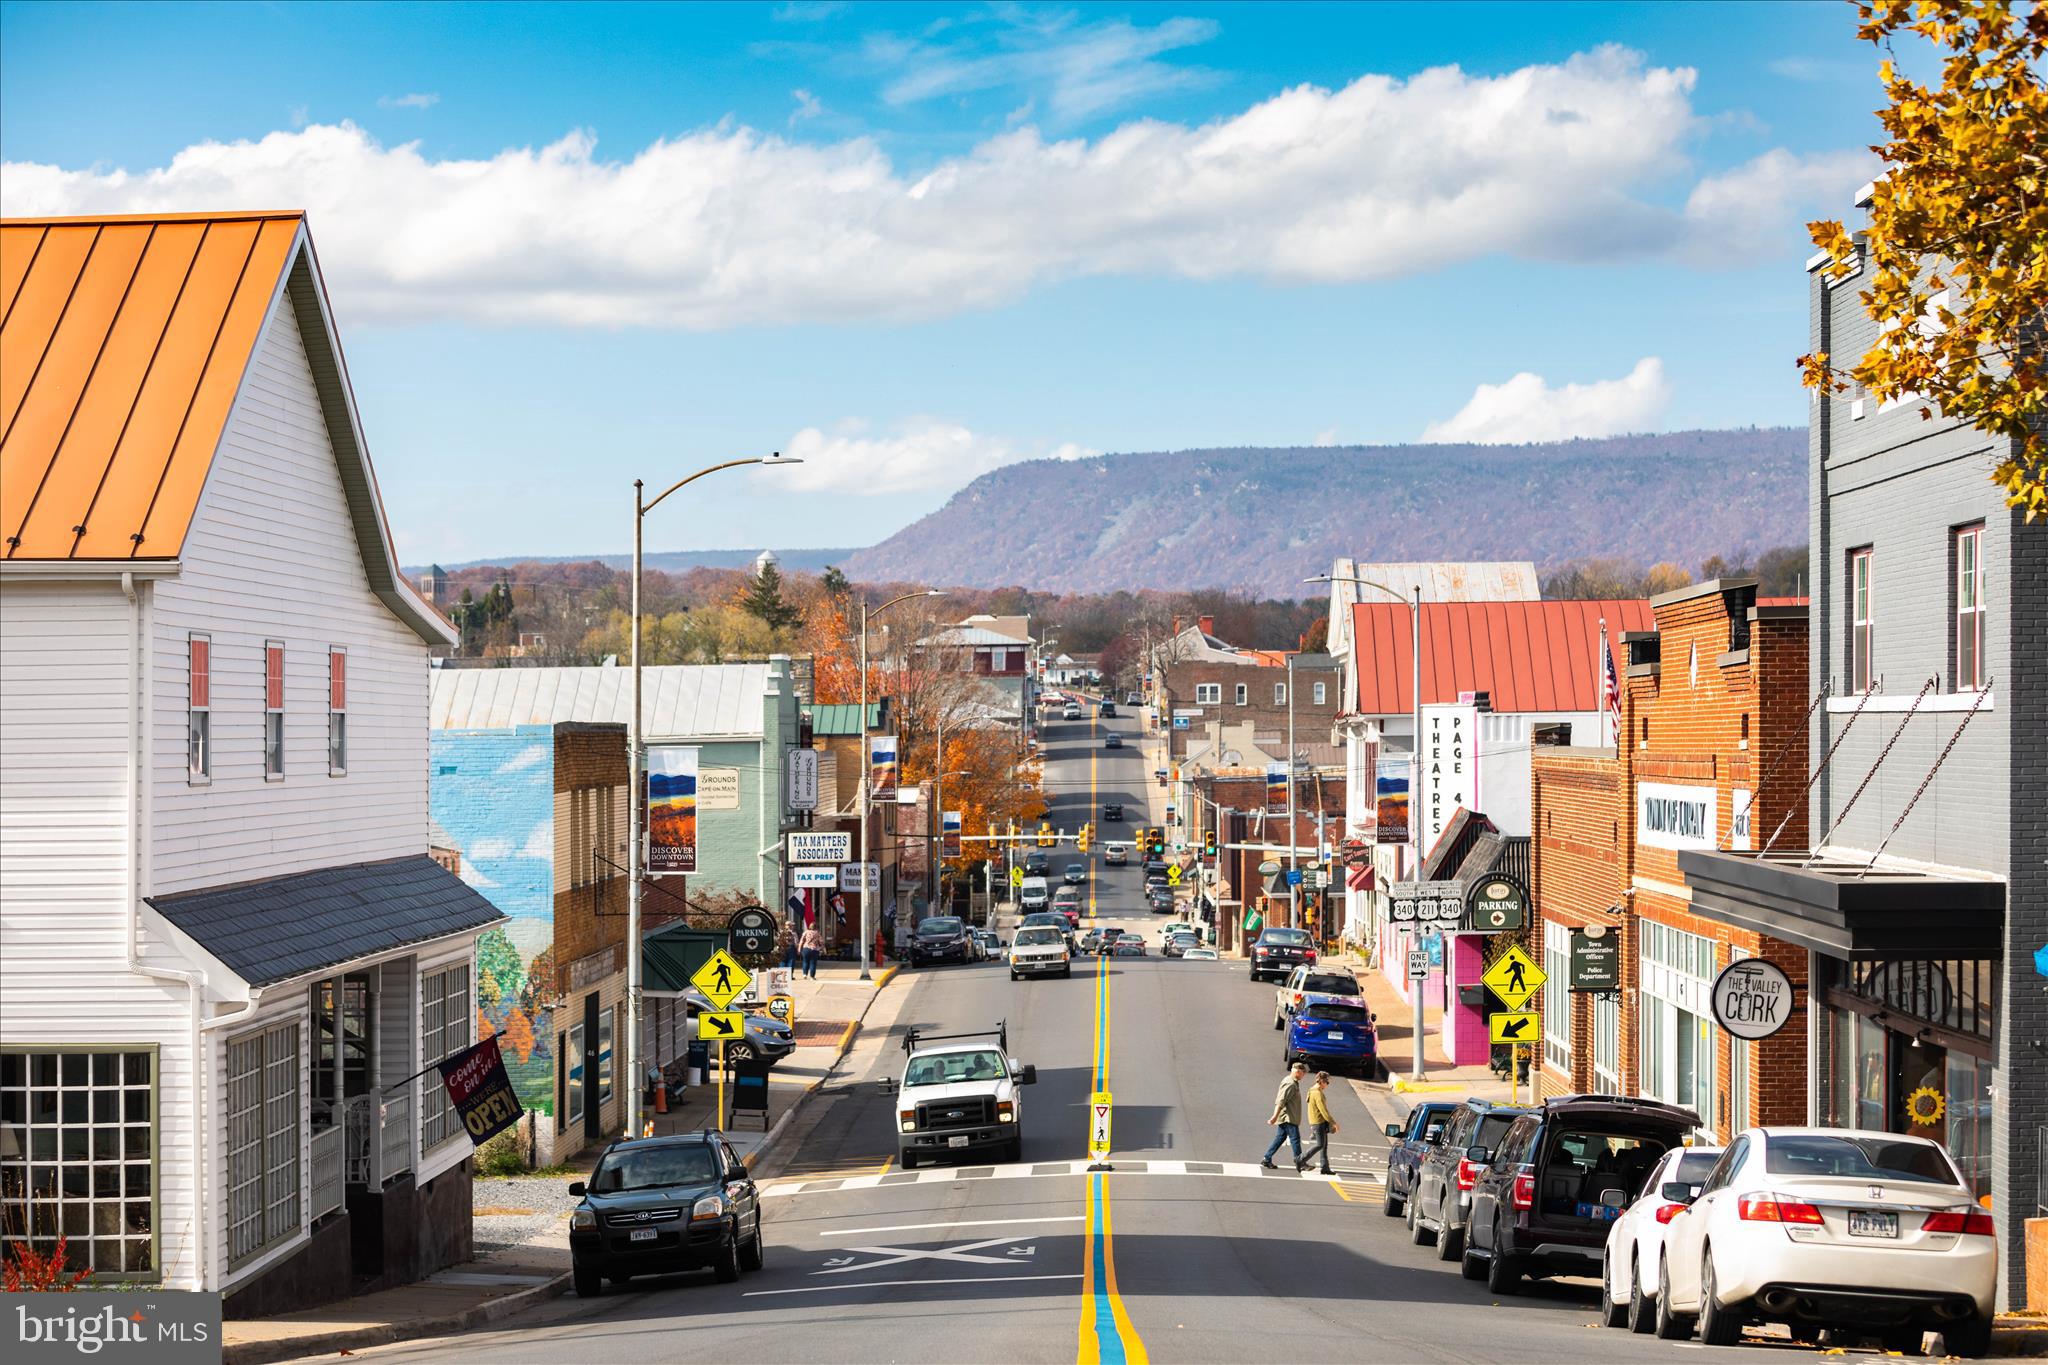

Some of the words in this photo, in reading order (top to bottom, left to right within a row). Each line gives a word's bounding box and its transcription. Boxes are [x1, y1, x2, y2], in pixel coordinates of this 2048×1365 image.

[1453, 717, 1462, 774] PAGE
[1432, 717, 1441, 834] THEATRES
[1454, 792, 1462, 804] 4
[793, 836, 808, 847] TAX
[810, 835, 847, 847] MATTERS
[797, 848, 844, 860] ASSOCIATES
[814, 873, 834, 881] PREP
[1397, 905, 1412, 915] 340
[1421, 904, 1434, 915] 211
[1442, 903, 1459, 914] 340
[1478, 901, 1518, 911] PARKING
[735, 928, 769, 938] PARKING
[1728, 977, 1743, 990] THE
[1752, 979, 1782, 994] VALLEY
[1725, 991, 1779, 1023] CORK
[449, 1053, 484, 1087] come
[464, 1073, 481, 1093] on
[466, 1086, 518, 1136] OPEN
